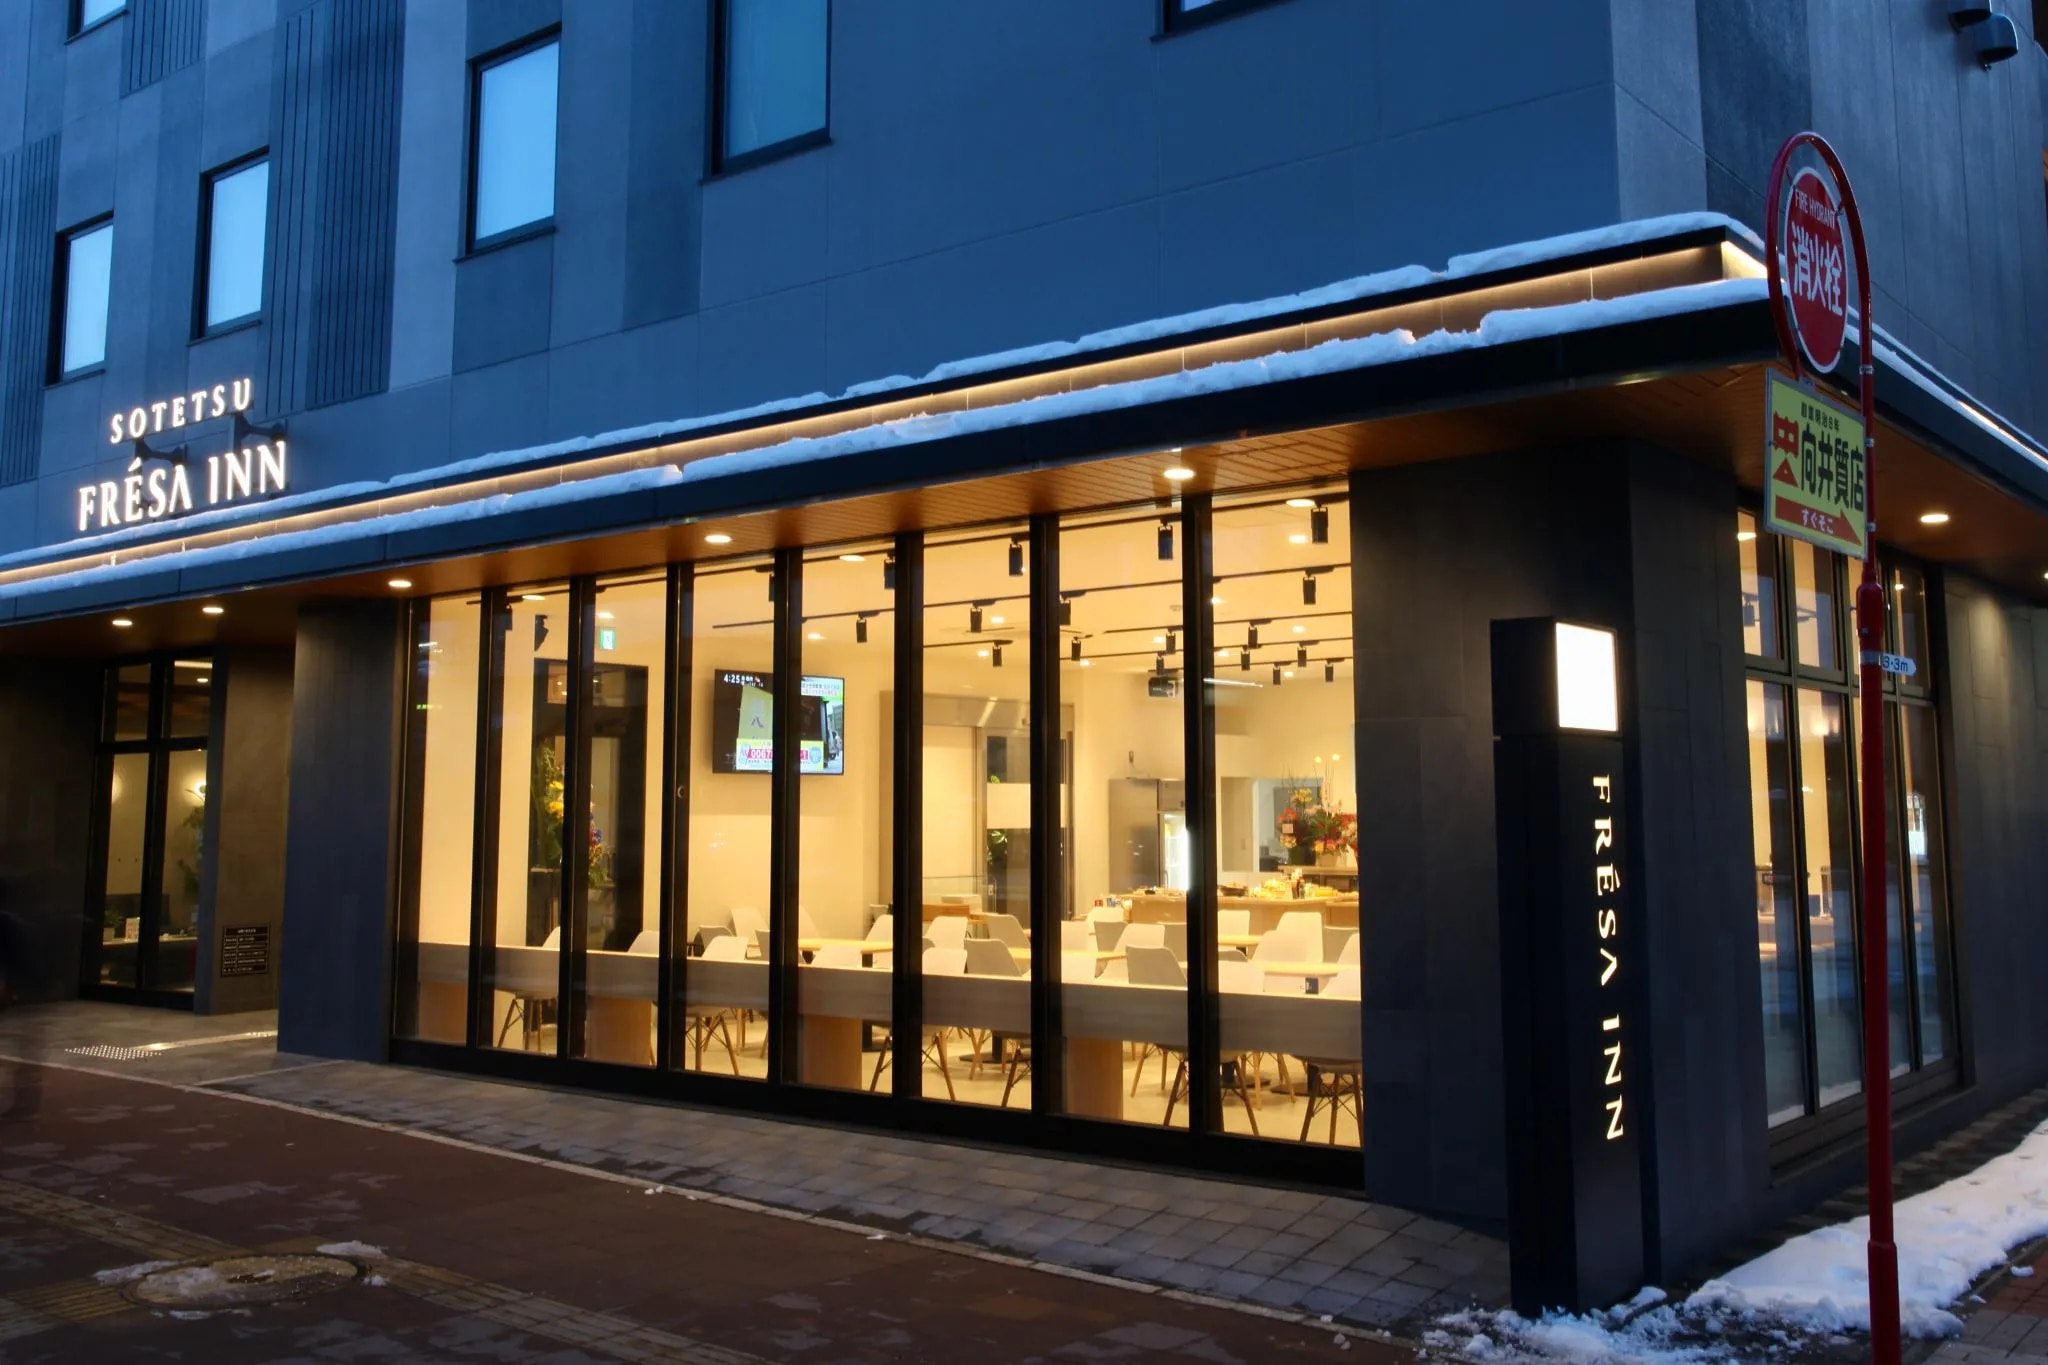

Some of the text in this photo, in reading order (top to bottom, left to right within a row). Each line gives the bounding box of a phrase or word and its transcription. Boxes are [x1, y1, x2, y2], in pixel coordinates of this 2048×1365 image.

[1795, 189, 1835, 230] FIRE HYDRANT
[1791, 220, 1843, 317] 消火栓
[110, 378, 251, 444] SOTETSU
[79, 440, 287, 532] FRÉSA INN
[1801, 422, 1864, 512] 向井質店
[1801, 508, 1835, 535] すぐそこ
[723, 673, 740, 684] 4:25
[1592, 773, 1624, 1141] FRÉSA INN
